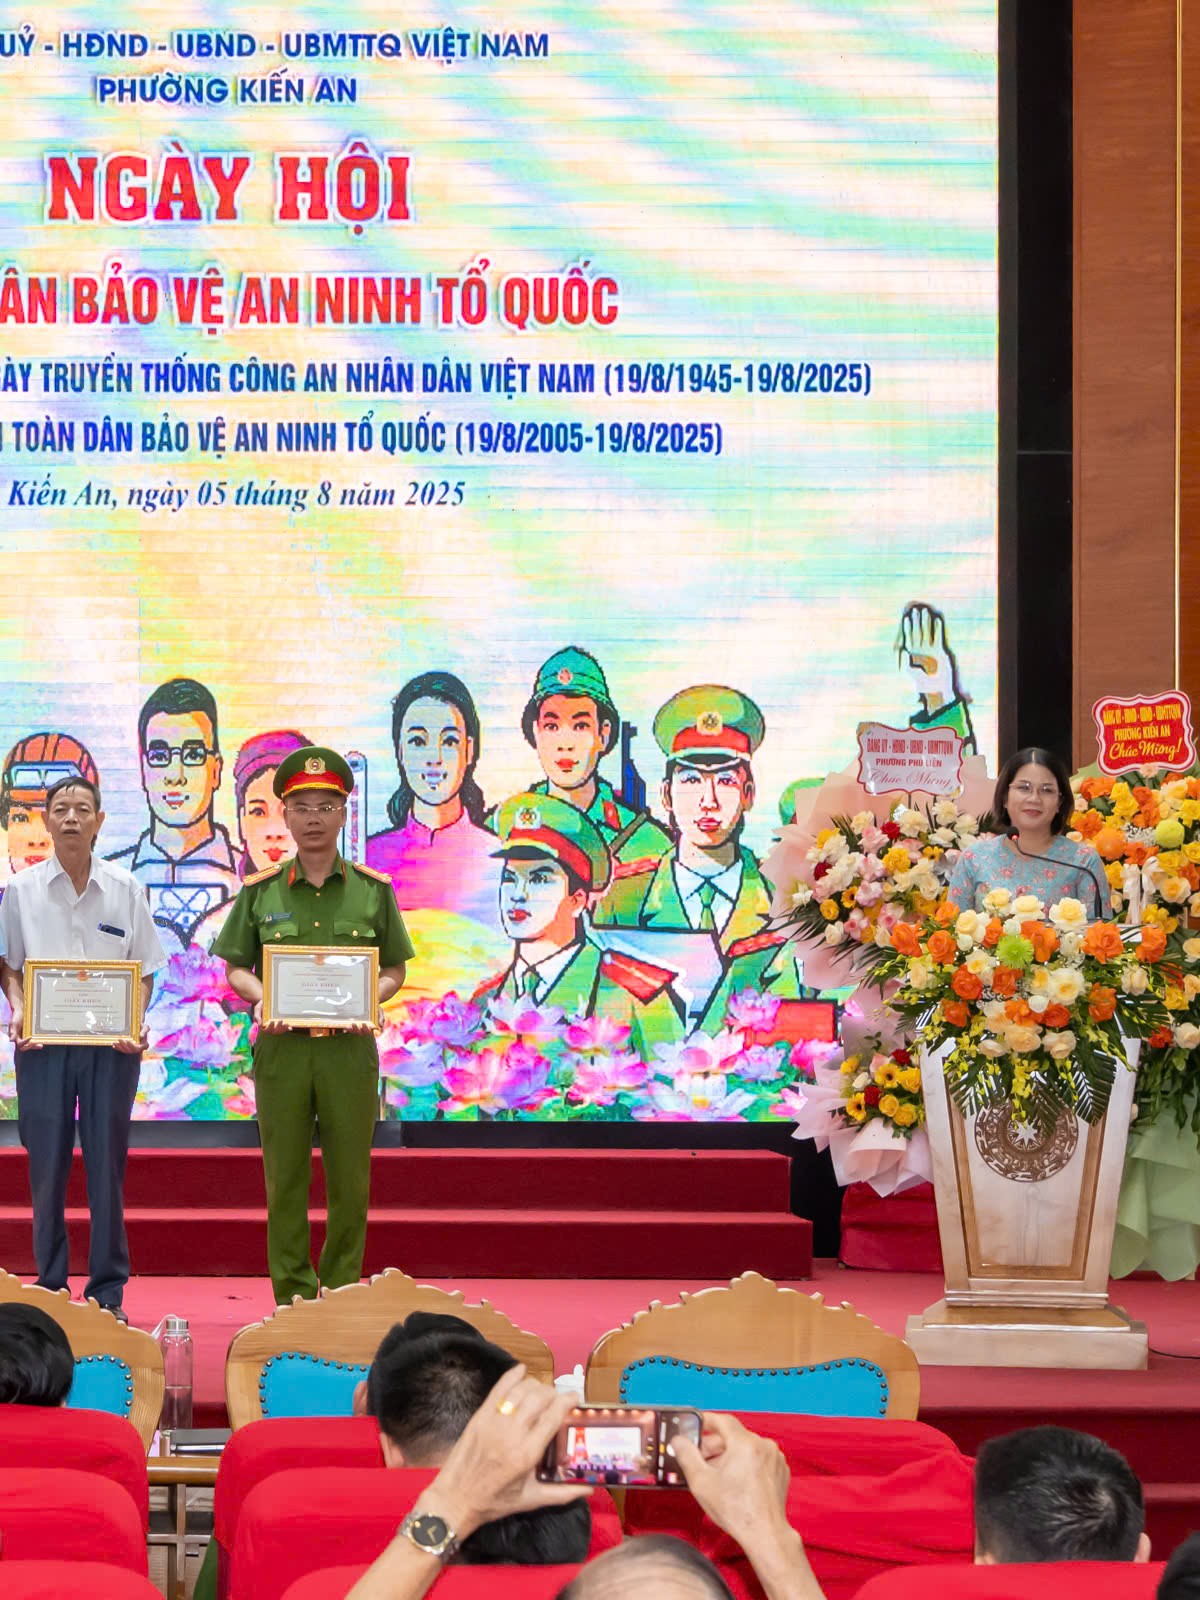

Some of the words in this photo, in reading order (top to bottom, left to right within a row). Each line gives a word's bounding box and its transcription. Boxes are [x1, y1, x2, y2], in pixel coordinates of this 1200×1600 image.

[0, 25, 35, 57] UỶ
[64, 34, 148, 57] HĐND
[176, 34, 256, 57] UBND
[284, 34, 402, 58] UBMTTQ
[410, 26, 471, 64] VIỆT
[482, 34, 548, 57] NAM
[100, 73, 228, 103] PHƯỜNG
[240, 69, 304, 103] KIẾN
[315, 79, 357, 102] AN
[48, 142, 250, 221] NGÀY
[279, 142, 410, 235] HỘI
[73, 262, 158, 324] BẢO
[173, 268, 224, 335] VỆ
[239, 277, 299, 324] AN
[315, 277, 421, 324] NINH
[437, 257, 490, 324] TỔ
[503, 260, 619, 330] QUỐC
[40, 352, 133, 393] TRUYỀN
[141, 352, 221, 393] THỐNG
[229, 356, 296, 393] CÔNG
[304, 363, 337, 393] AN
[346, 356, 414, 393] NHÂN
[422, 356, 472, 393] DÂN
[480, 357, 530, 400] VIỆT
[538, 363, 595, 393] NAM
[604, 362, 872, 396] (19/8/1945-19/8/2025)
[12, 415, 74, 452] TOÀN
[84, 415, 133, 452] DÂN
[141, 412, 190, 452] BẢO
[198, 416, 226, 459] VỆ
[234, 422, 268, 452] AN
[277, 422, 337, 452] NINH
[344, 410, 374, 452] TỔ
[381, 411, 446, 455] QUỐC
[455, 421, 723, 456] (19/8/2005-19/8/2025)
[8, 473, 67, 506] Kiến
[73, 482, 118, 511] An,
[127, 482, 189, 512] ngày
[196, 481, 227, 506] 05
[234, 479, 308, 512] tháng
[317, 481, 331, 506] 8
[339, 482, 395, 506] năm
[404, 480, 466, 506] 2025
[1160, 724, 1171, 737] AN
[1109, 743, 1139, 760] Chúc
